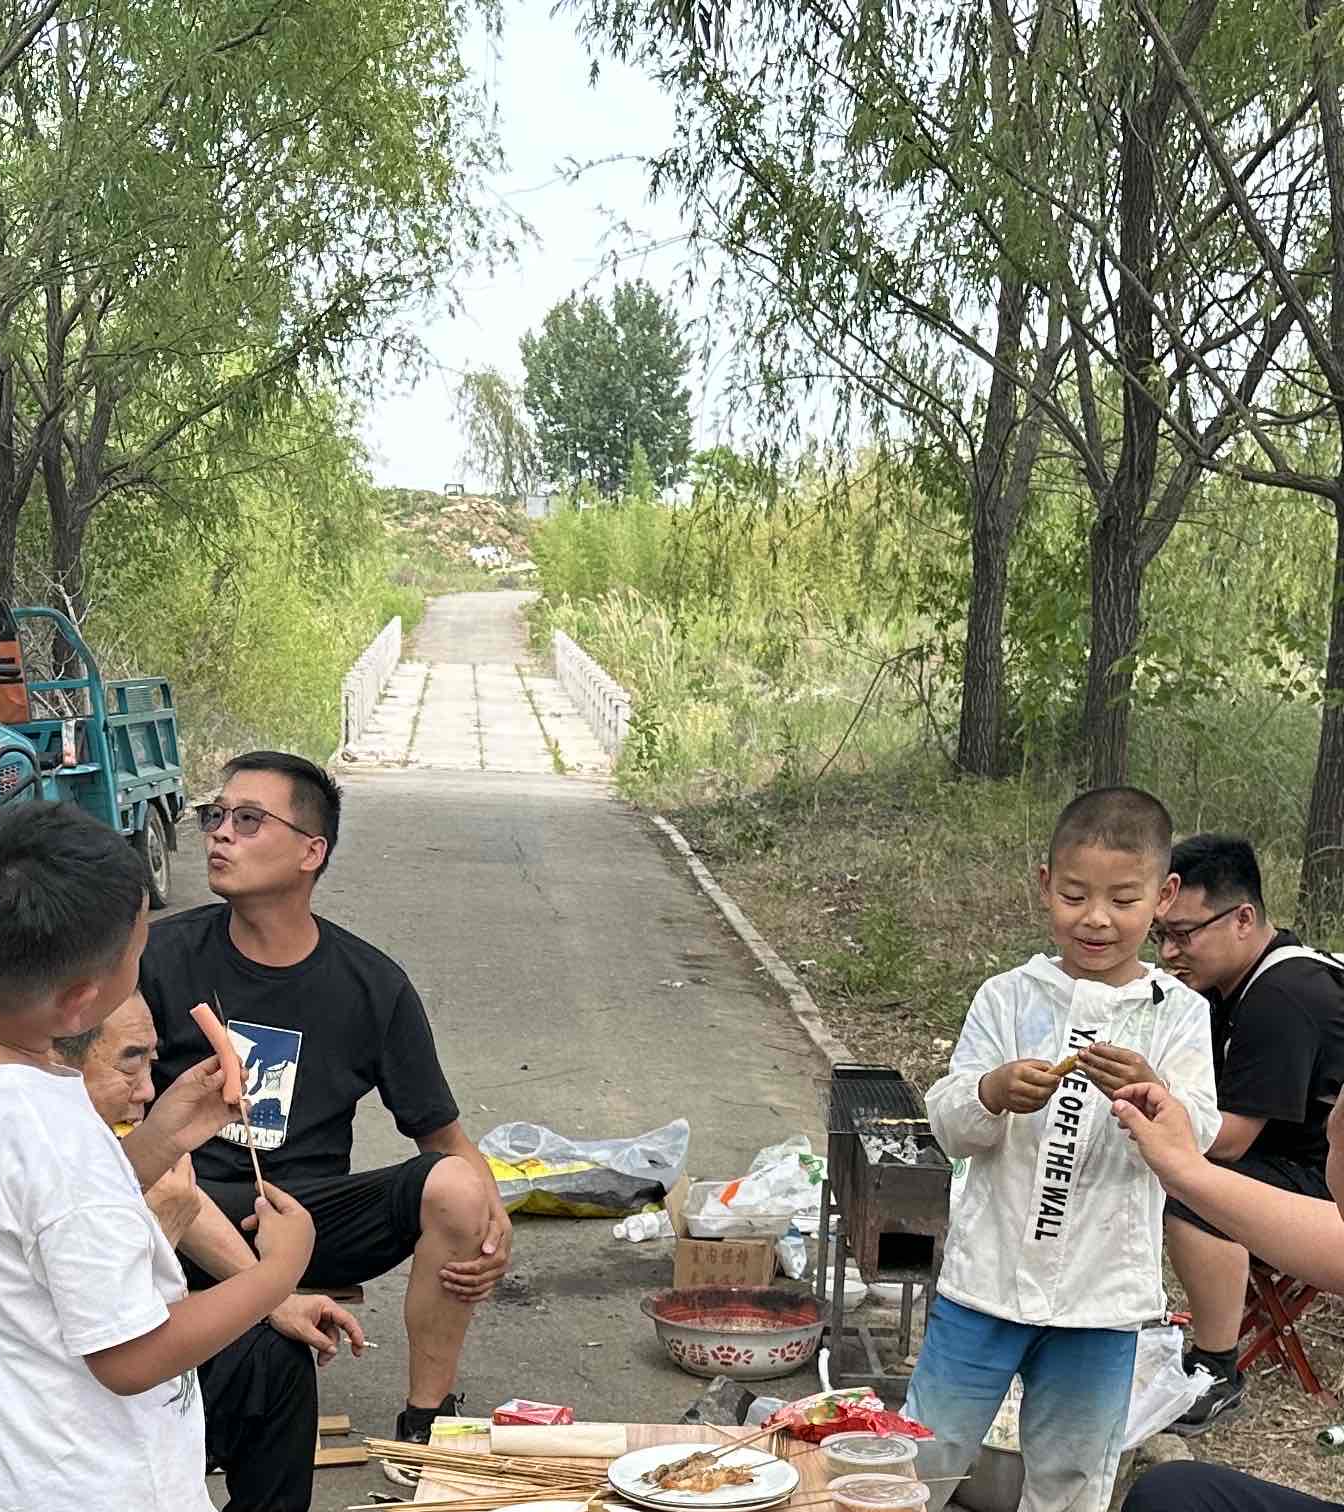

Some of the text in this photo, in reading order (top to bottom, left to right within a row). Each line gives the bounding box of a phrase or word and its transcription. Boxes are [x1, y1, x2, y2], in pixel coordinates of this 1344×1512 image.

[1055, 1095, 1084, 1138] OFF
[1046, 1141, 1077, 1183] THE
[1034, 1185, 1069, 1240] WALL
